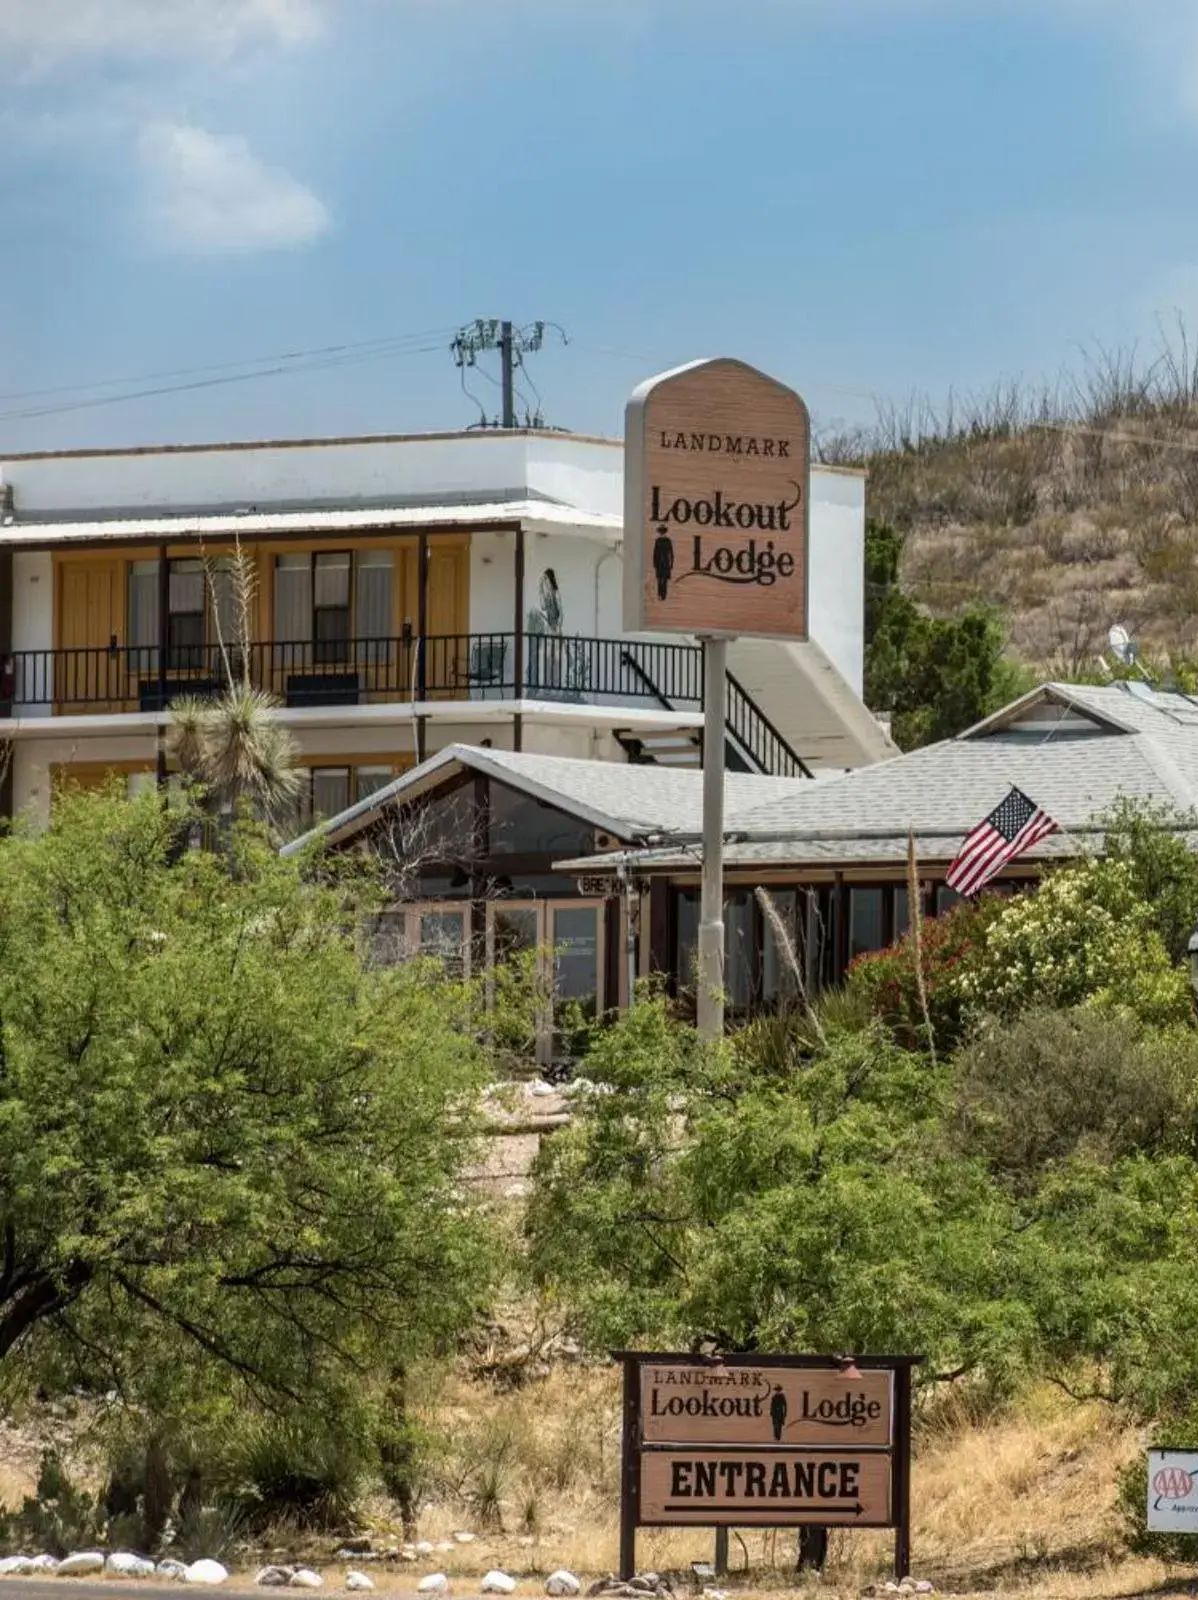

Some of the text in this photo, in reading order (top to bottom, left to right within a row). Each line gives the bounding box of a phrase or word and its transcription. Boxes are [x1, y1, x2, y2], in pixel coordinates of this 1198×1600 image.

[660, 430, 790, 458] LANDMARK
[650, 480, 801, 531] Lookout
[673, 535, 795, 586] Lodge
[651, 1380, 881, 1427] Lookout Lodge
[671, 1461, 860, 1498] ENTRANCE
[1156, 1468, 1190, 1498] AAA
